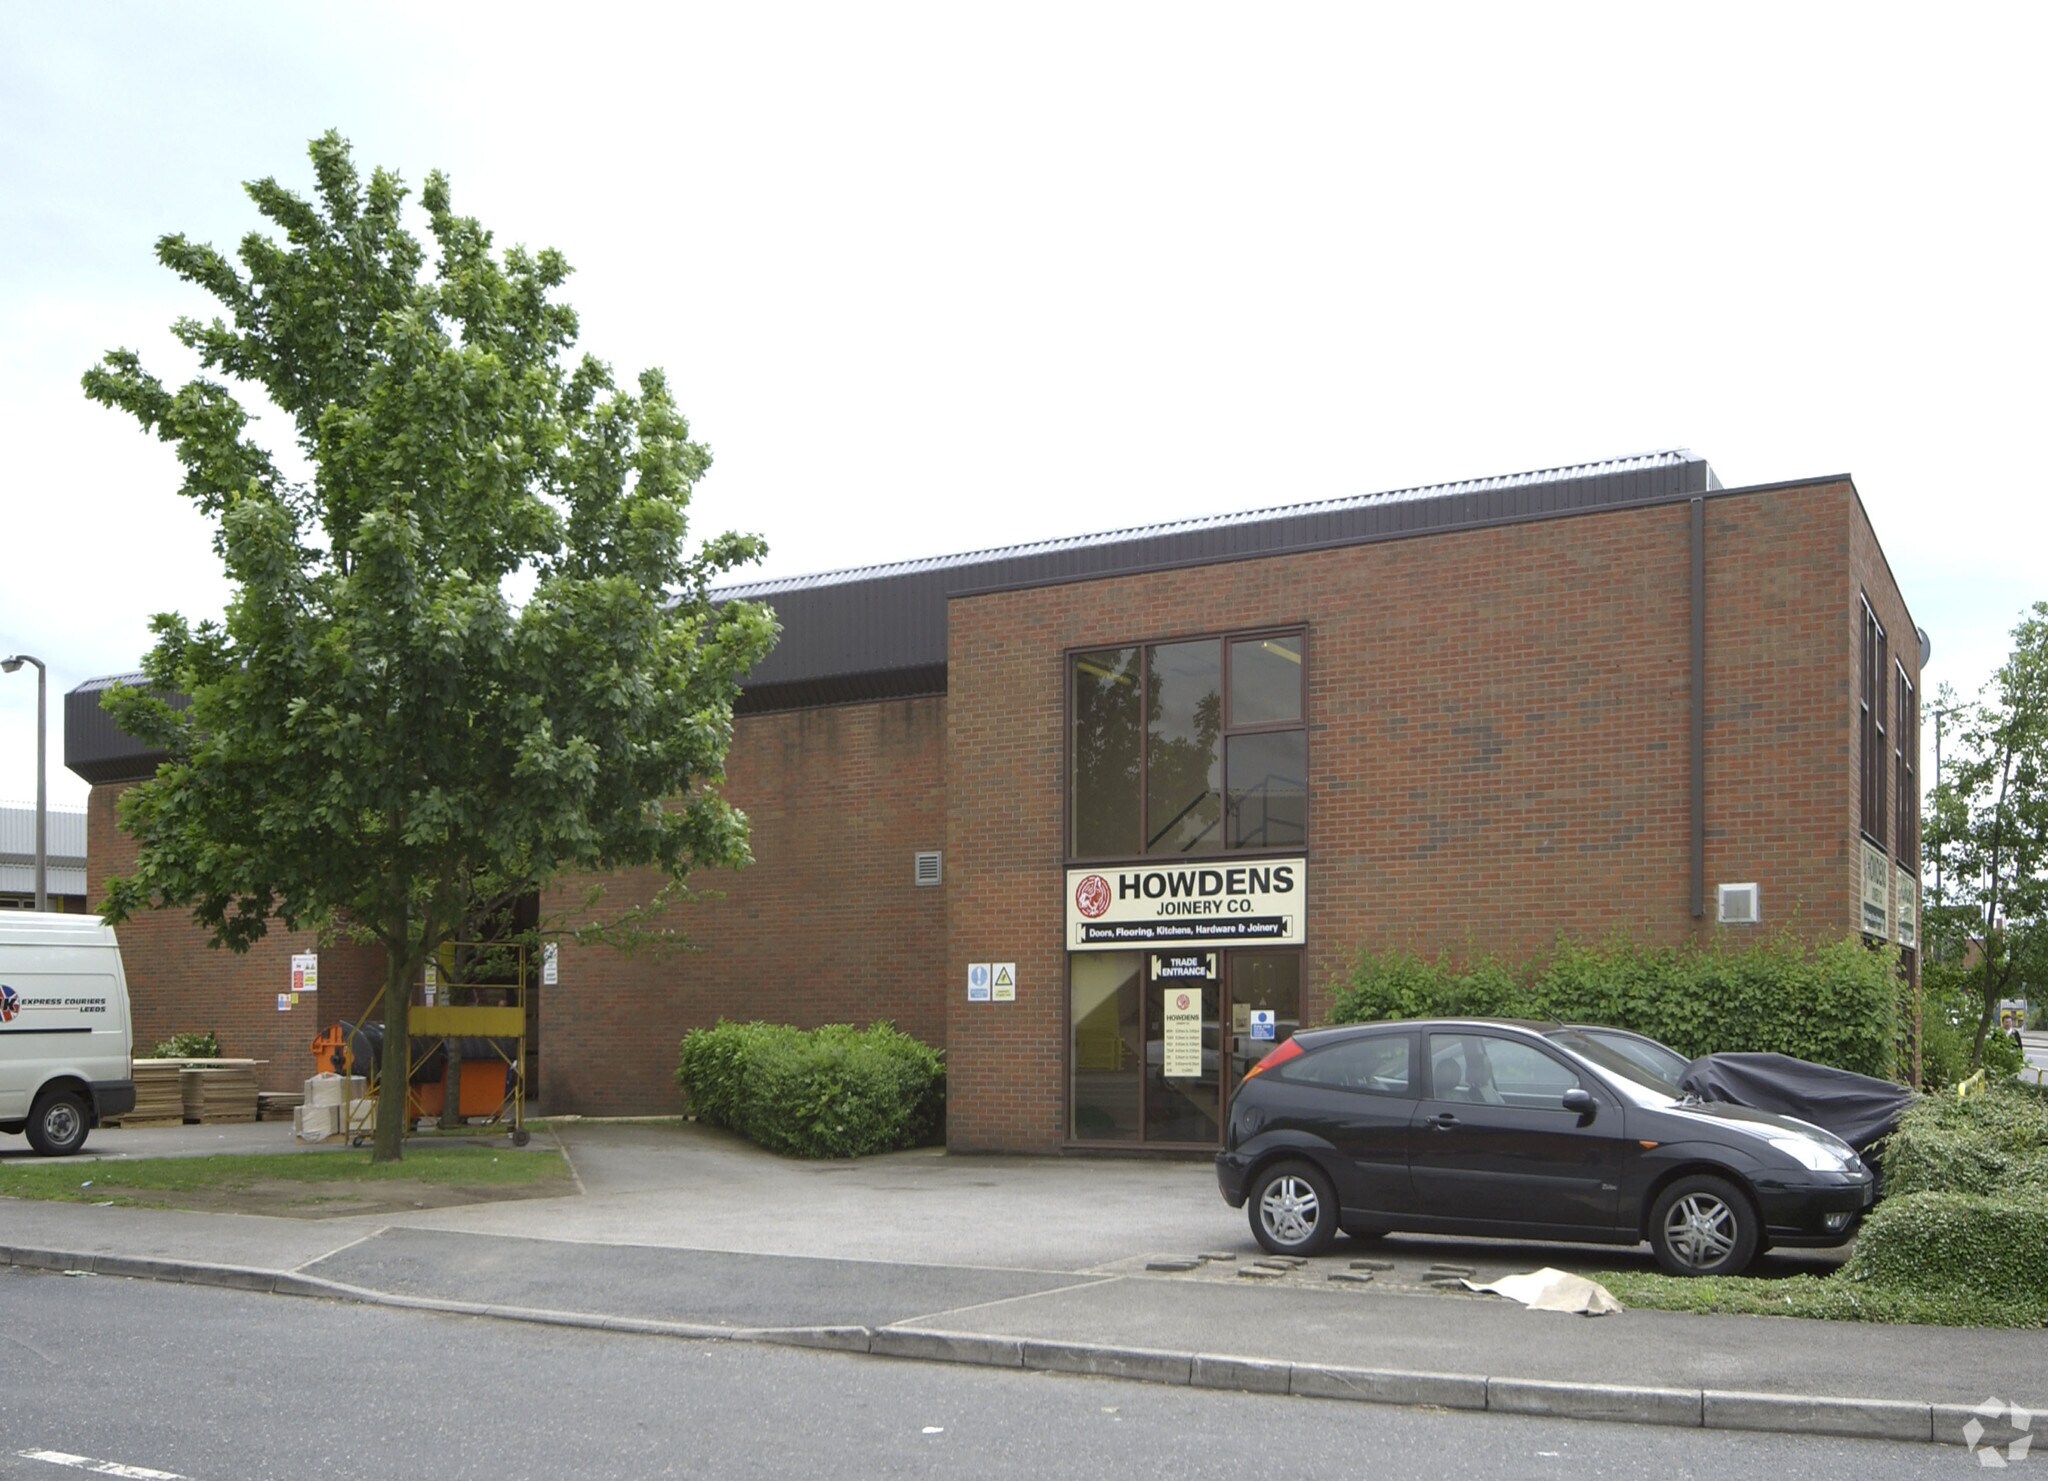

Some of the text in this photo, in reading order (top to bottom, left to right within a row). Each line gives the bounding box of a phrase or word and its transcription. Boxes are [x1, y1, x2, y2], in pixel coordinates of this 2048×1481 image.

[1119, 867, 1294, 900] HOWDENS
[1156, 899, 1255, 916] JOINERY CO.
[1089, 928, 1115, 938] Doors,
[1116, 927, 1155, 938] Flooring,
[1156, 925, 1194, 936] Kitchens,
[1195, 924, 1236, 934] Hardware
[1247, 923, 1278, 934] Joinery
[1171, 957, 1198, 967] TRADE
[1162, 967, 1206, 977] ENTRANCE
[0, 998, 17, 1011] K
